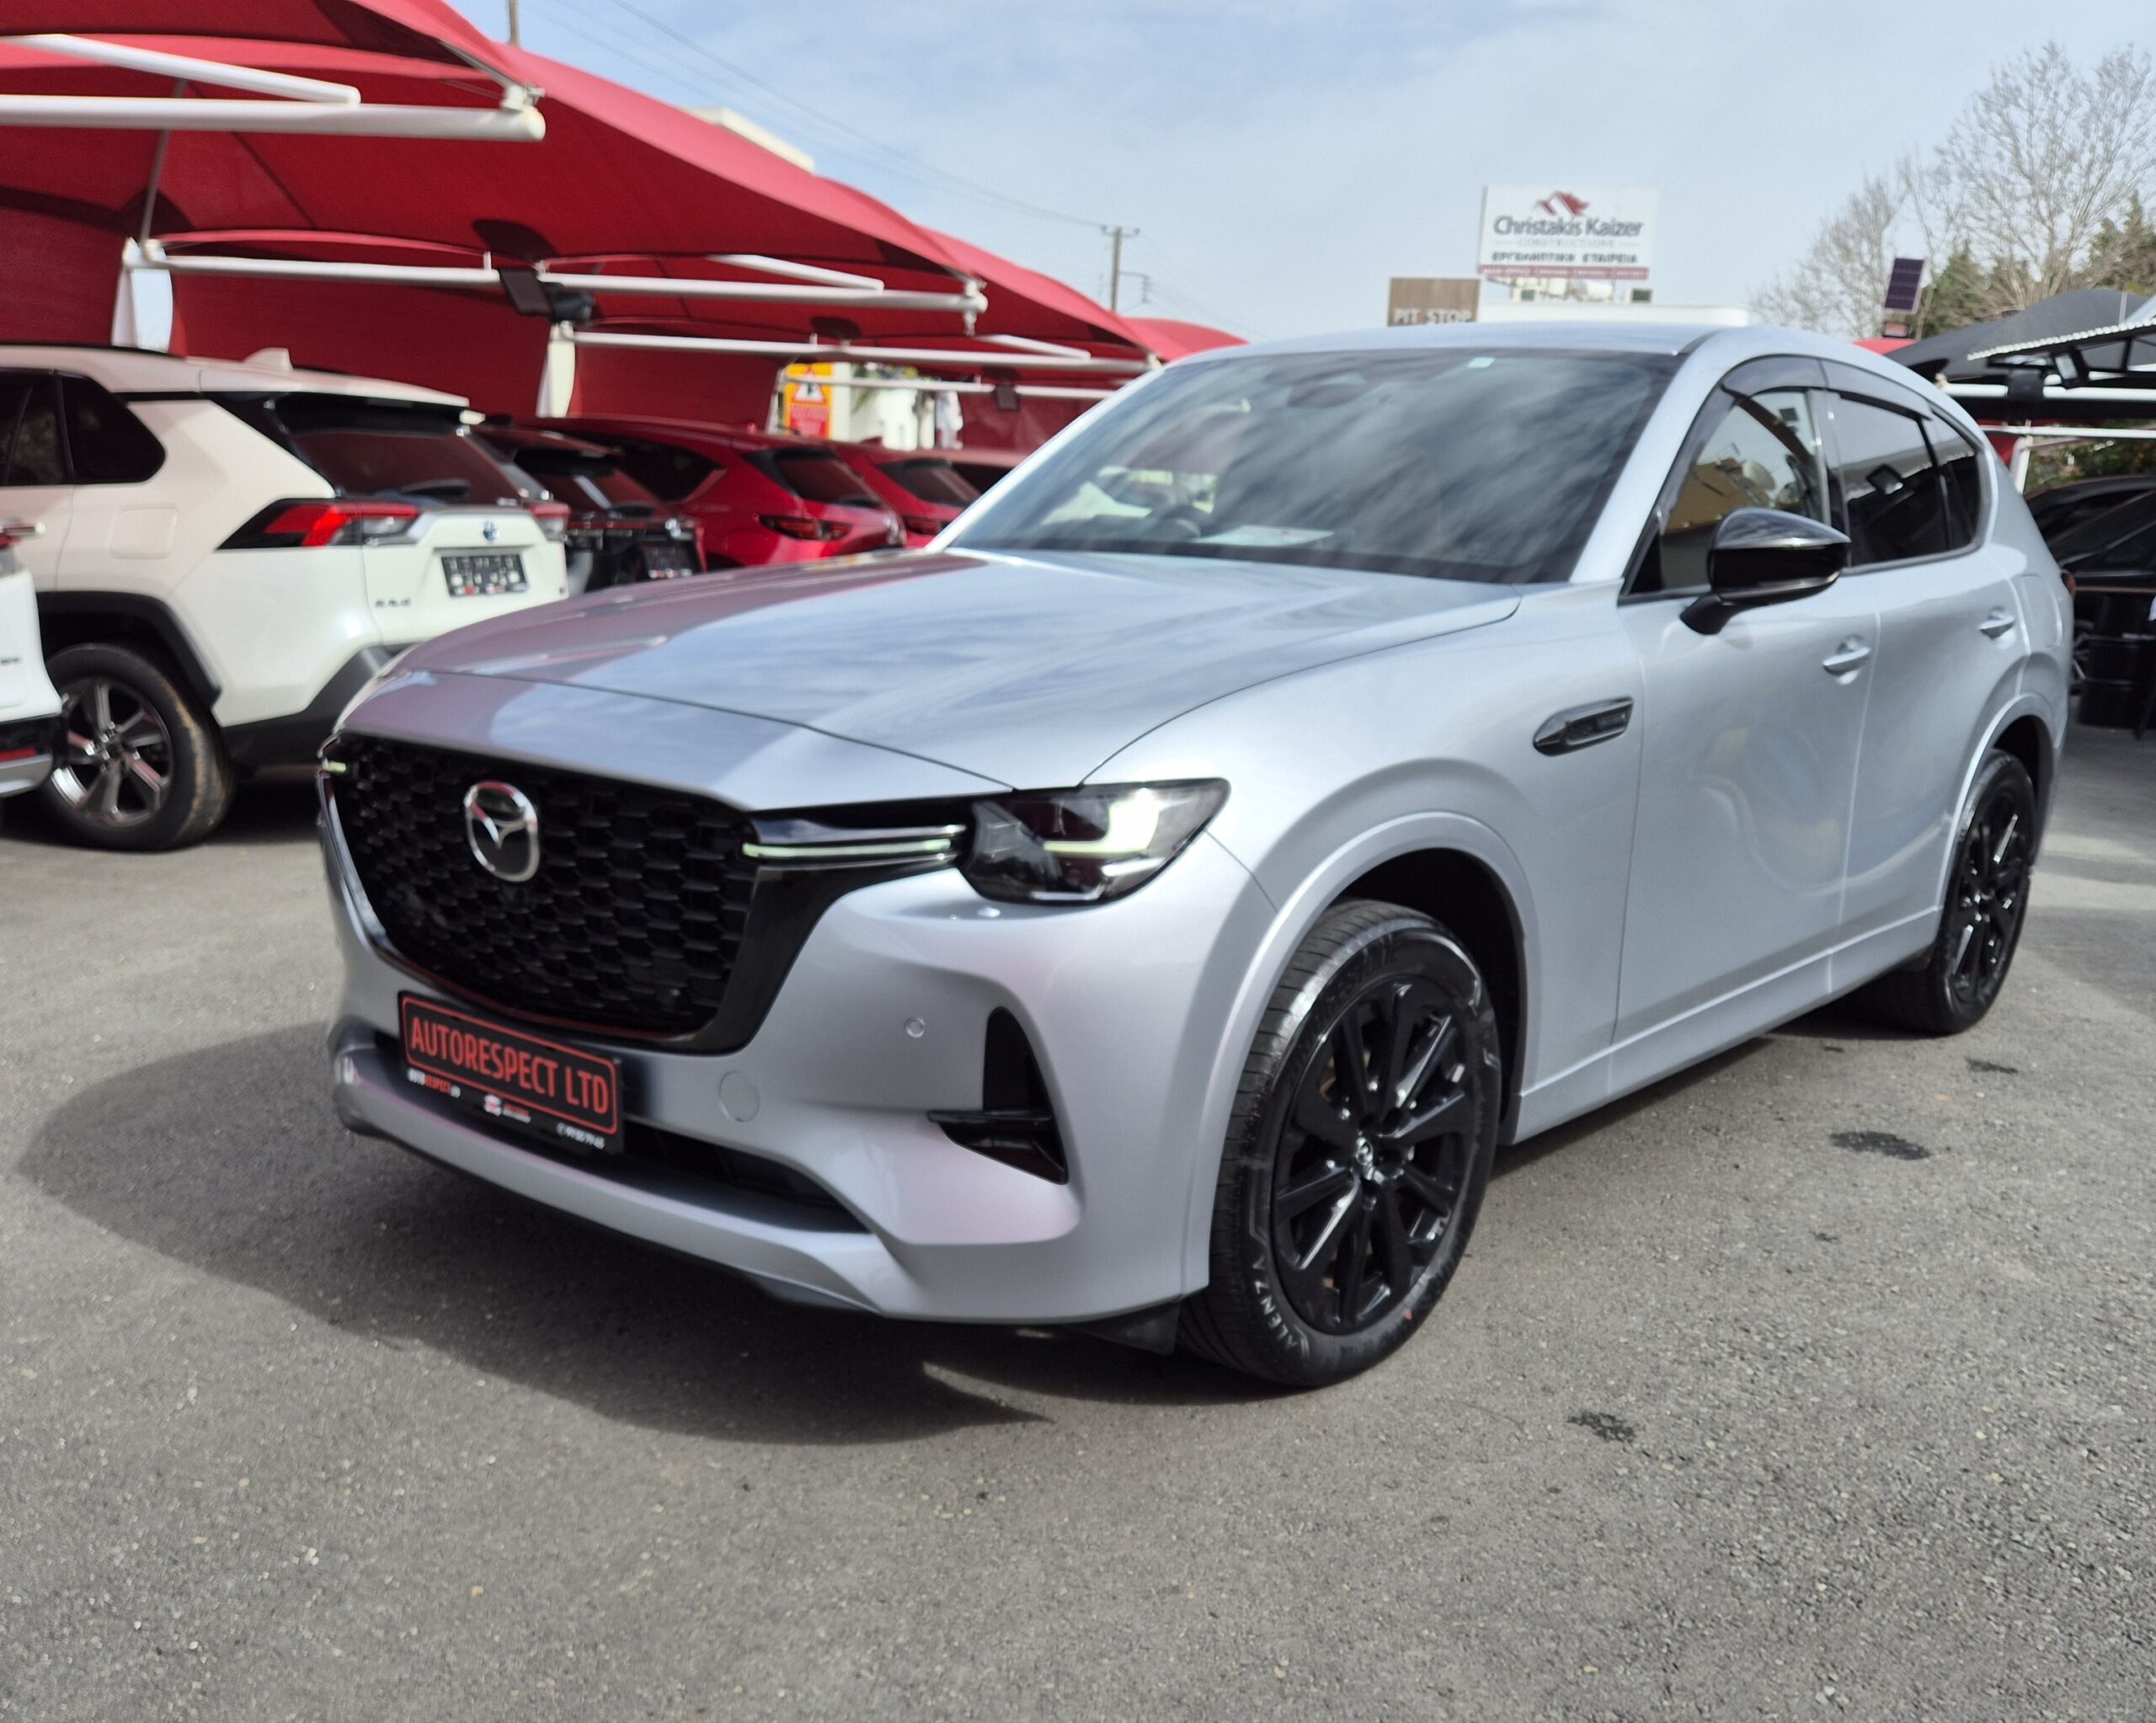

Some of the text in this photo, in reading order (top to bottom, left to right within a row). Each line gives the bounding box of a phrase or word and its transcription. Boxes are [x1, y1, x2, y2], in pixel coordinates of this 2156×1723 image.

[1493, 216, 1643, 237] Christakis Kaizer
[1393, 307, 1473, 324] PIT STOP
[411, 1016, 609, 1115] AUTORESPECT LTD
